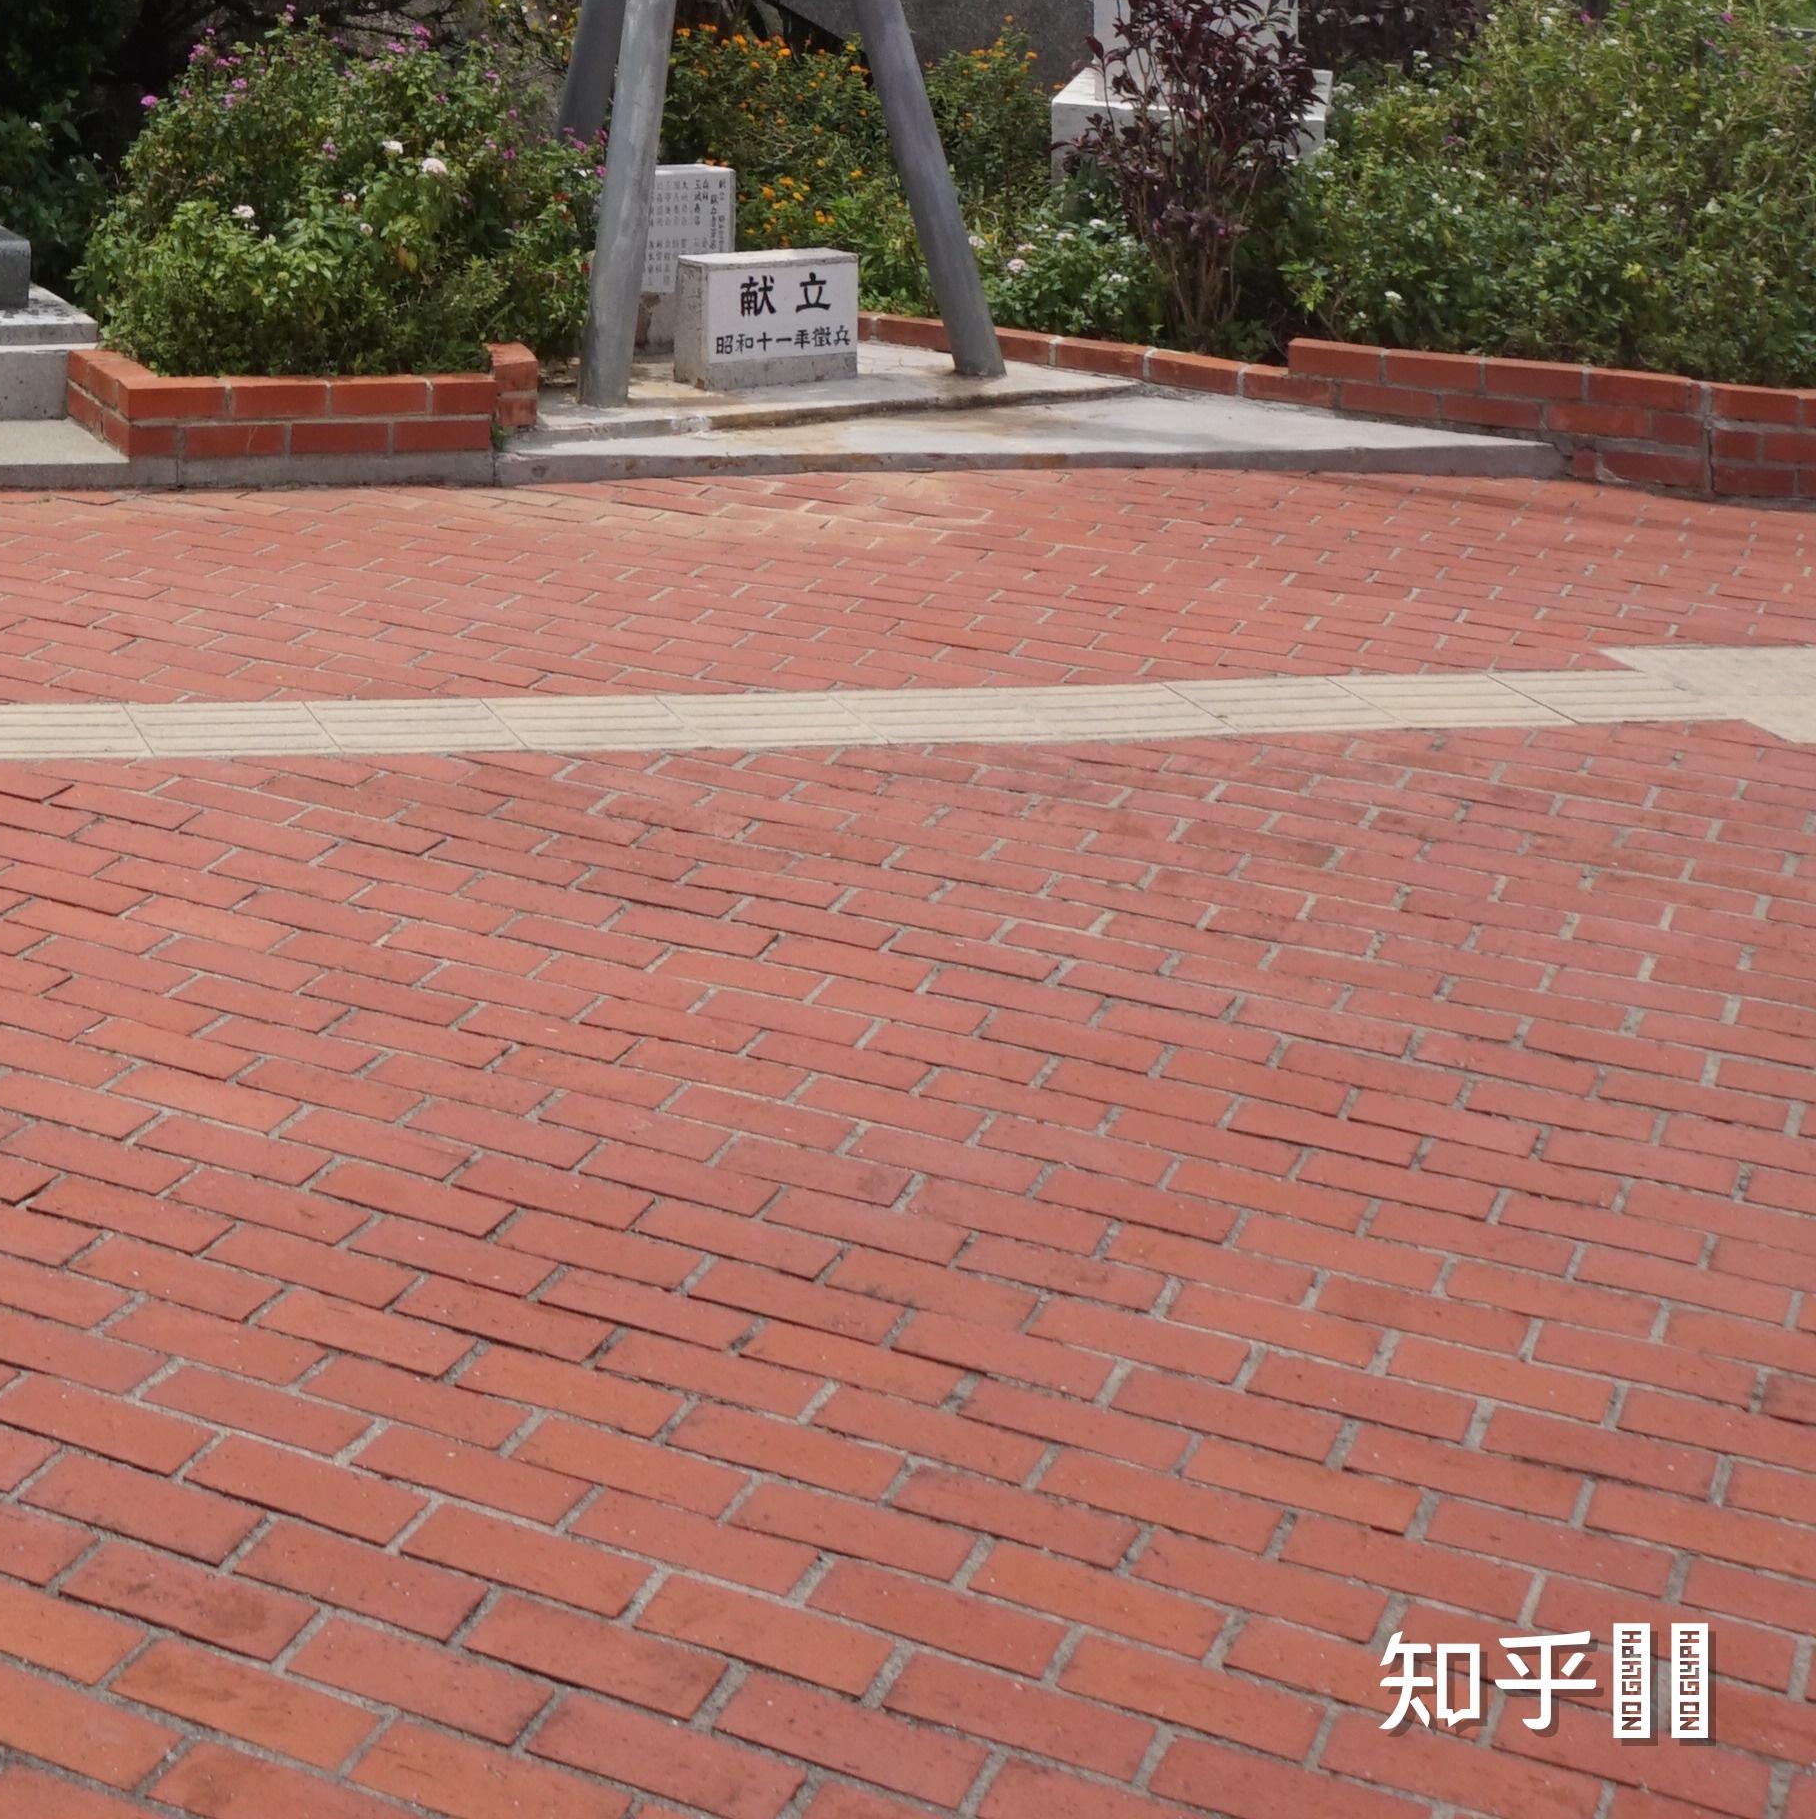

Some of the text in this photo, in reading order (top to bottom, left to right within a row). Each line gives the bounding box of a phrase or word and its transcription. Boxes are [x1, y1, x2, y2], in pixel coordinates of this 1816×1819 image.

[740, 271, 832, 318] 献立
[715, 324, 851, 355] 昭和十一年徴兵
